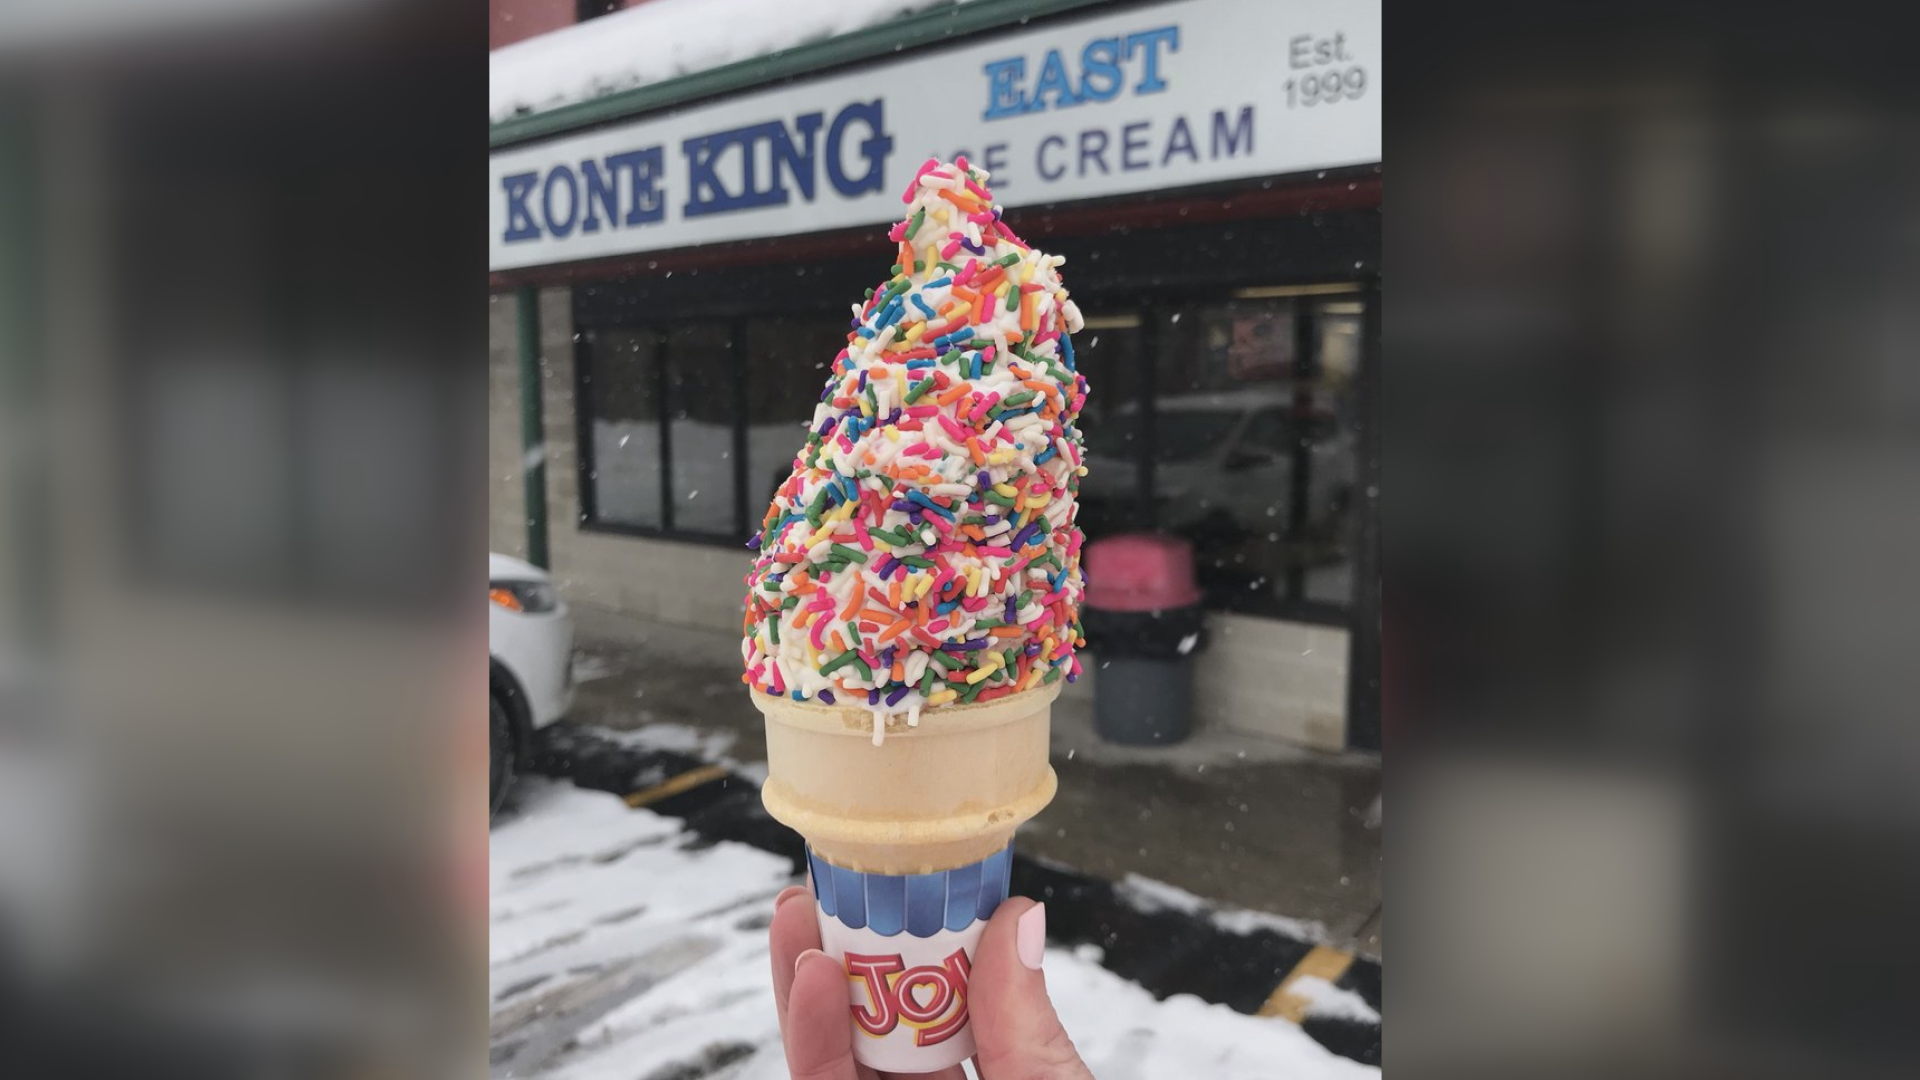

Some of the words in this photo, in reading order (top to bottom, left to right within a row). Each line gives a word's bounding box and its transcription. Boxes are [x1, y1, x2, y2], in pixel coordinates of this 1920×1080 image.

[982, 26, 1180, 121] EAST
[1283, 66, 1368, 109] 1999
[1289, 31, 1354, 69] Est.
[502, 145, 666, 243] KONE
[681, 98, 893, 218] KING
[1036, 106, 1257, 182] CREAM
